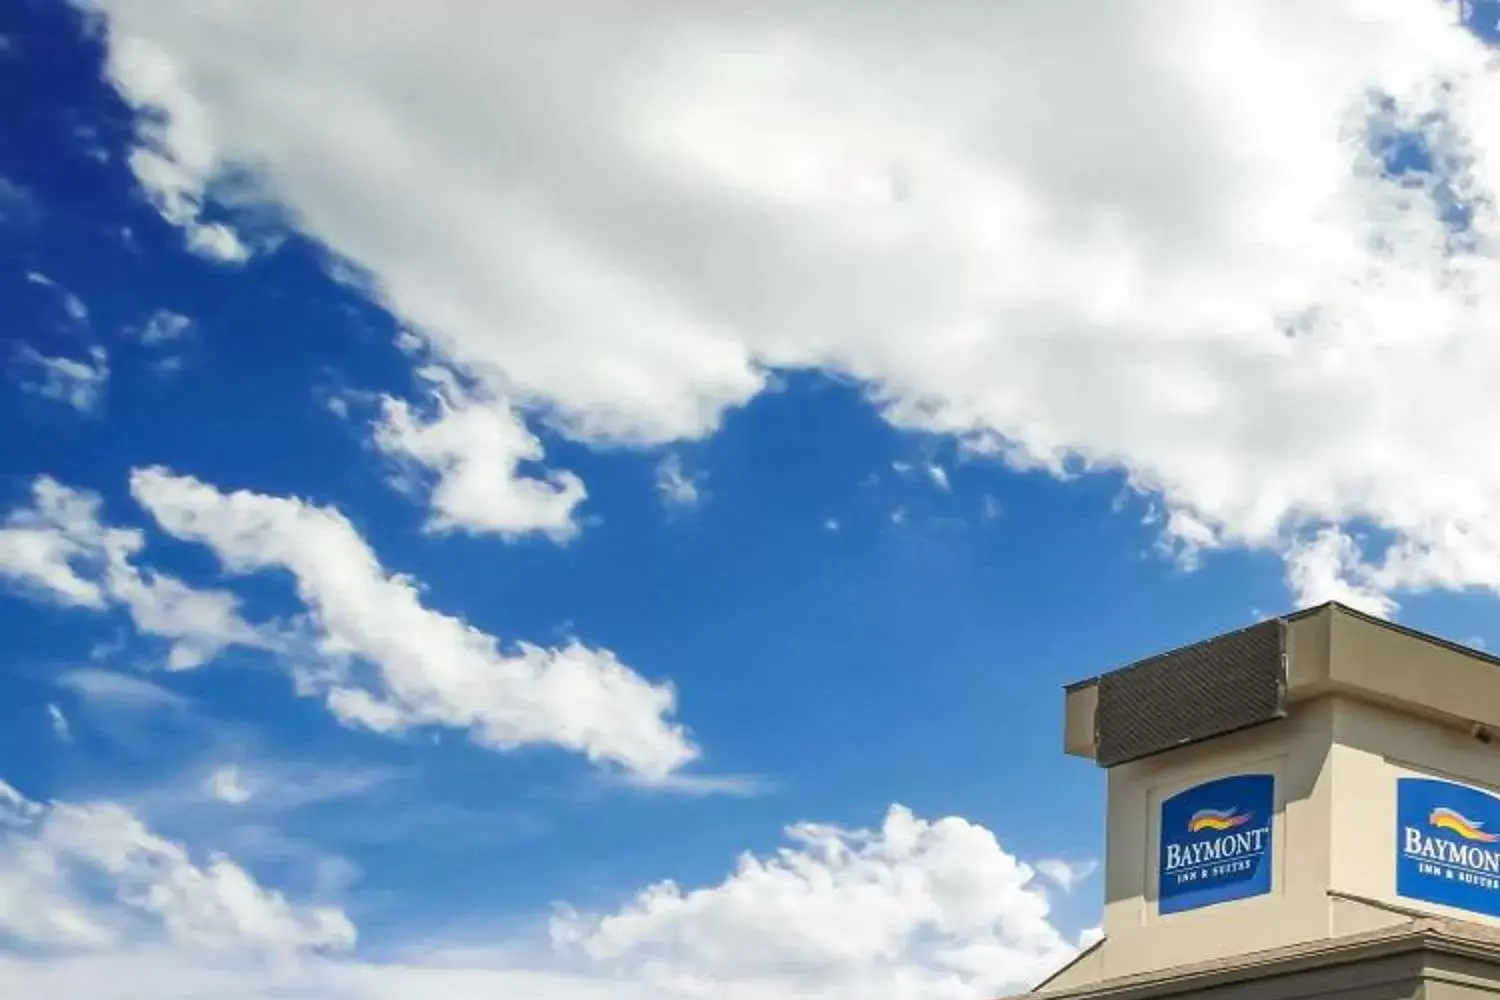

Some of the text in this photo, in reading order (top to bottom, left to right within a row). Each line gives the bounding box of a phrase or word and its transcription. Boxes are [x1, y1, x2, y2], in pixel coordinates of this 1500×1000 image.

[1166, 829, 1264, 871] BAYMONT
[1177, 859, 1252, 884] INN & SUITES
[1418, 862, 1442, 876] INN
[1445, 868, 1454, 879] &
